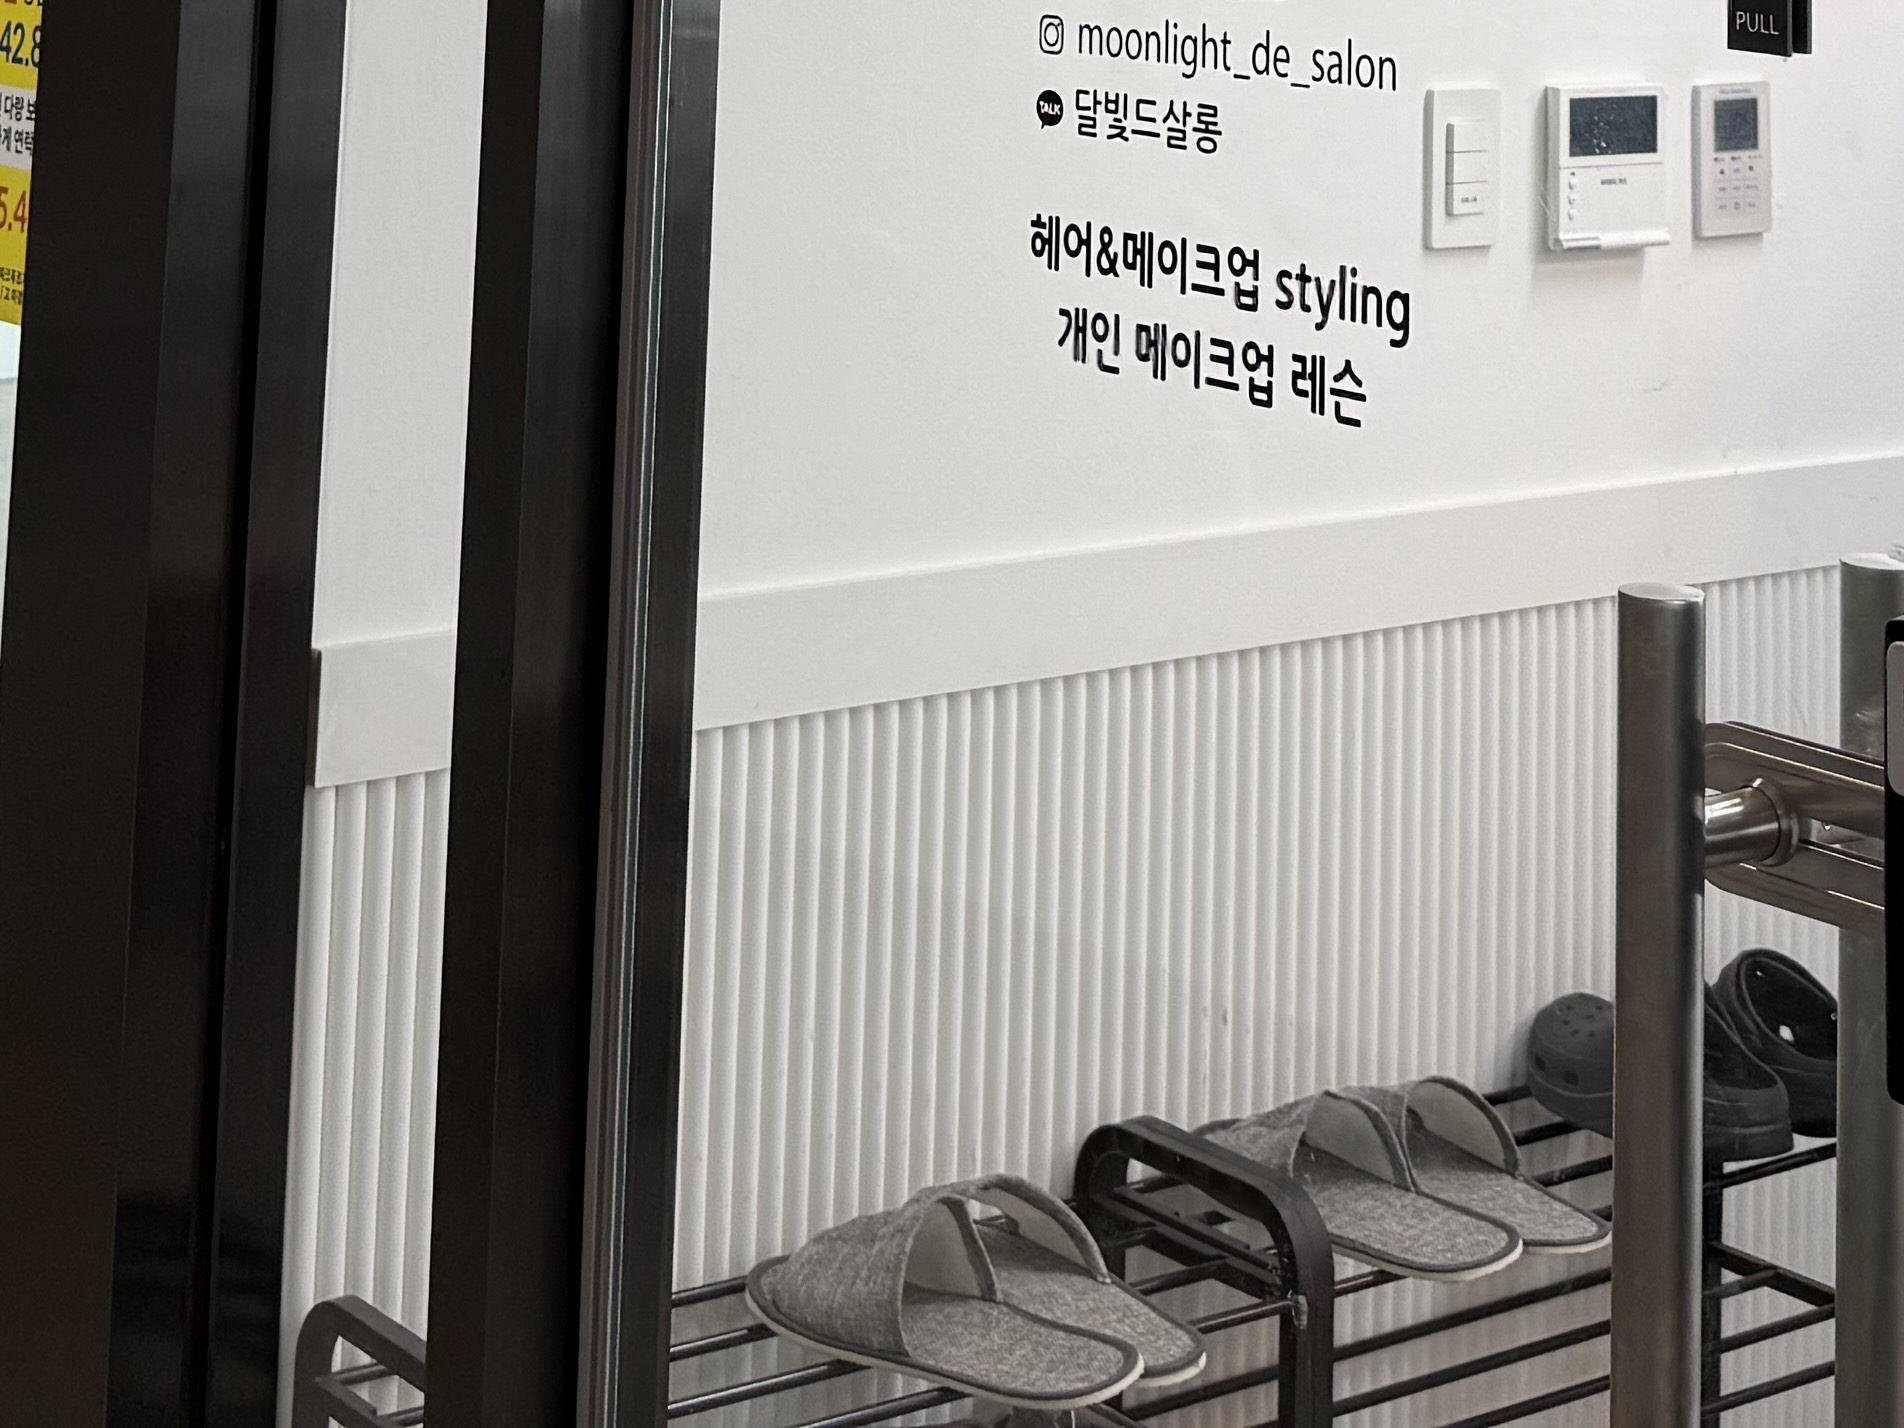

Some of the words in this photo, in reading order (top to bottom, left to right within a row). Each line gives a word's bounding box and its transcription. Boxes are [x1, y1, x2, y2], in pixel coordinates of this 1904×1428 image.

[1078, 18, 1398, 91] moonlight_de_salon
[1736, 11, 1780, 35] PULL
[1075, 88, 1222, 154] 달빛드살롱
[1030, 213, 1260, 313] 헤어&메이크업
[1275, 262, 1412, 348] styling
[1057, 306, 1120, 375] 개인
[1135, 322, 1274, 409] 메이크업
[1291, 353, 1368, 429] 레슨
